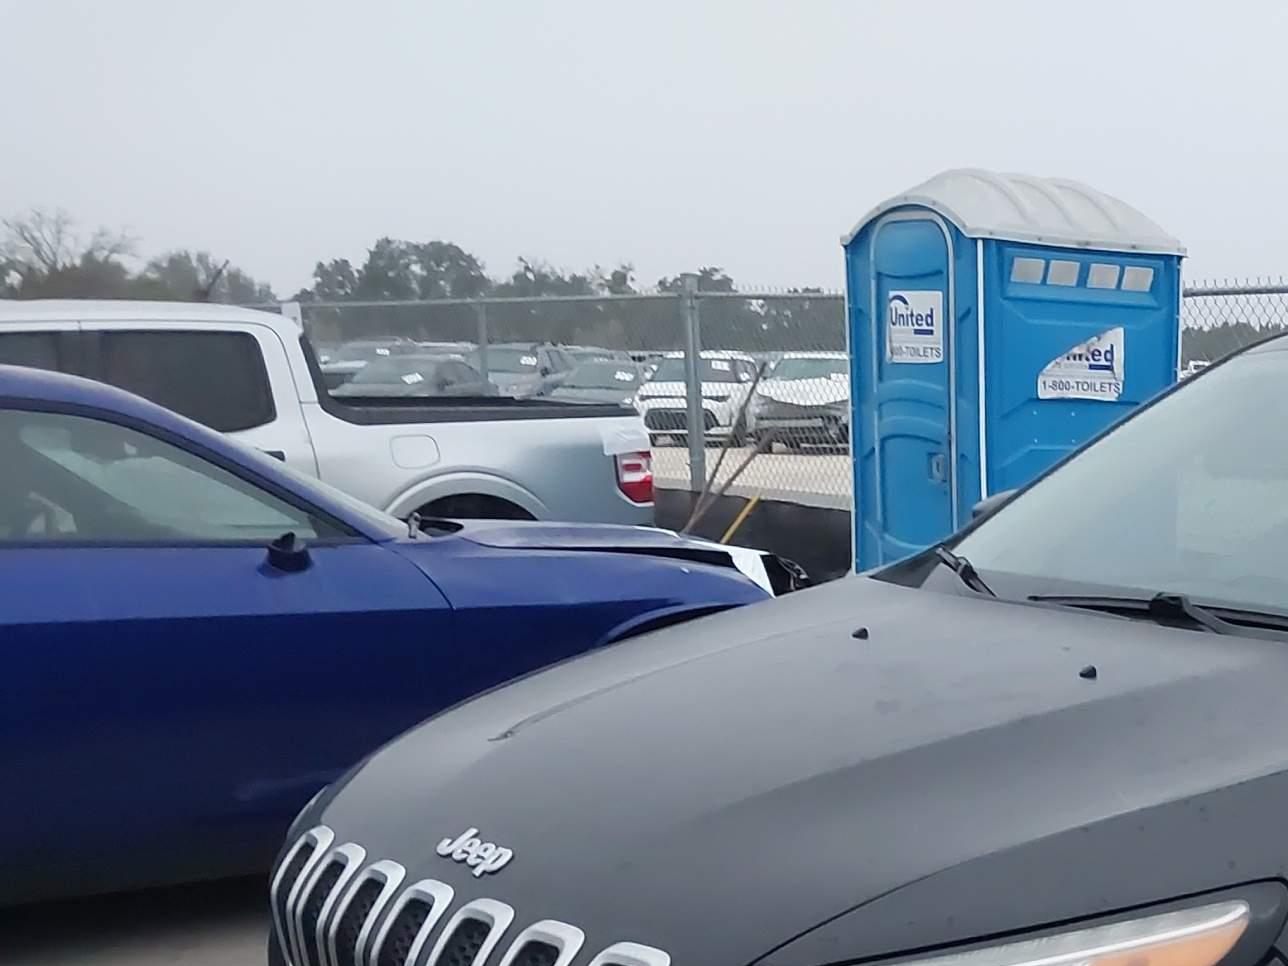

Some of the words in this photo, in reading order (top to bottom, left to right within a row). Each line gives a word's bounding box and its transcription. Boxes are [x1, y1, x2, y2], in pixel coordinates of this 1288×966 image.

[890, 306, 934, 327] United
[1042, 380, 1121, 394] 1-800-TOILETS
[436, 827, 513, 878] Jeep
